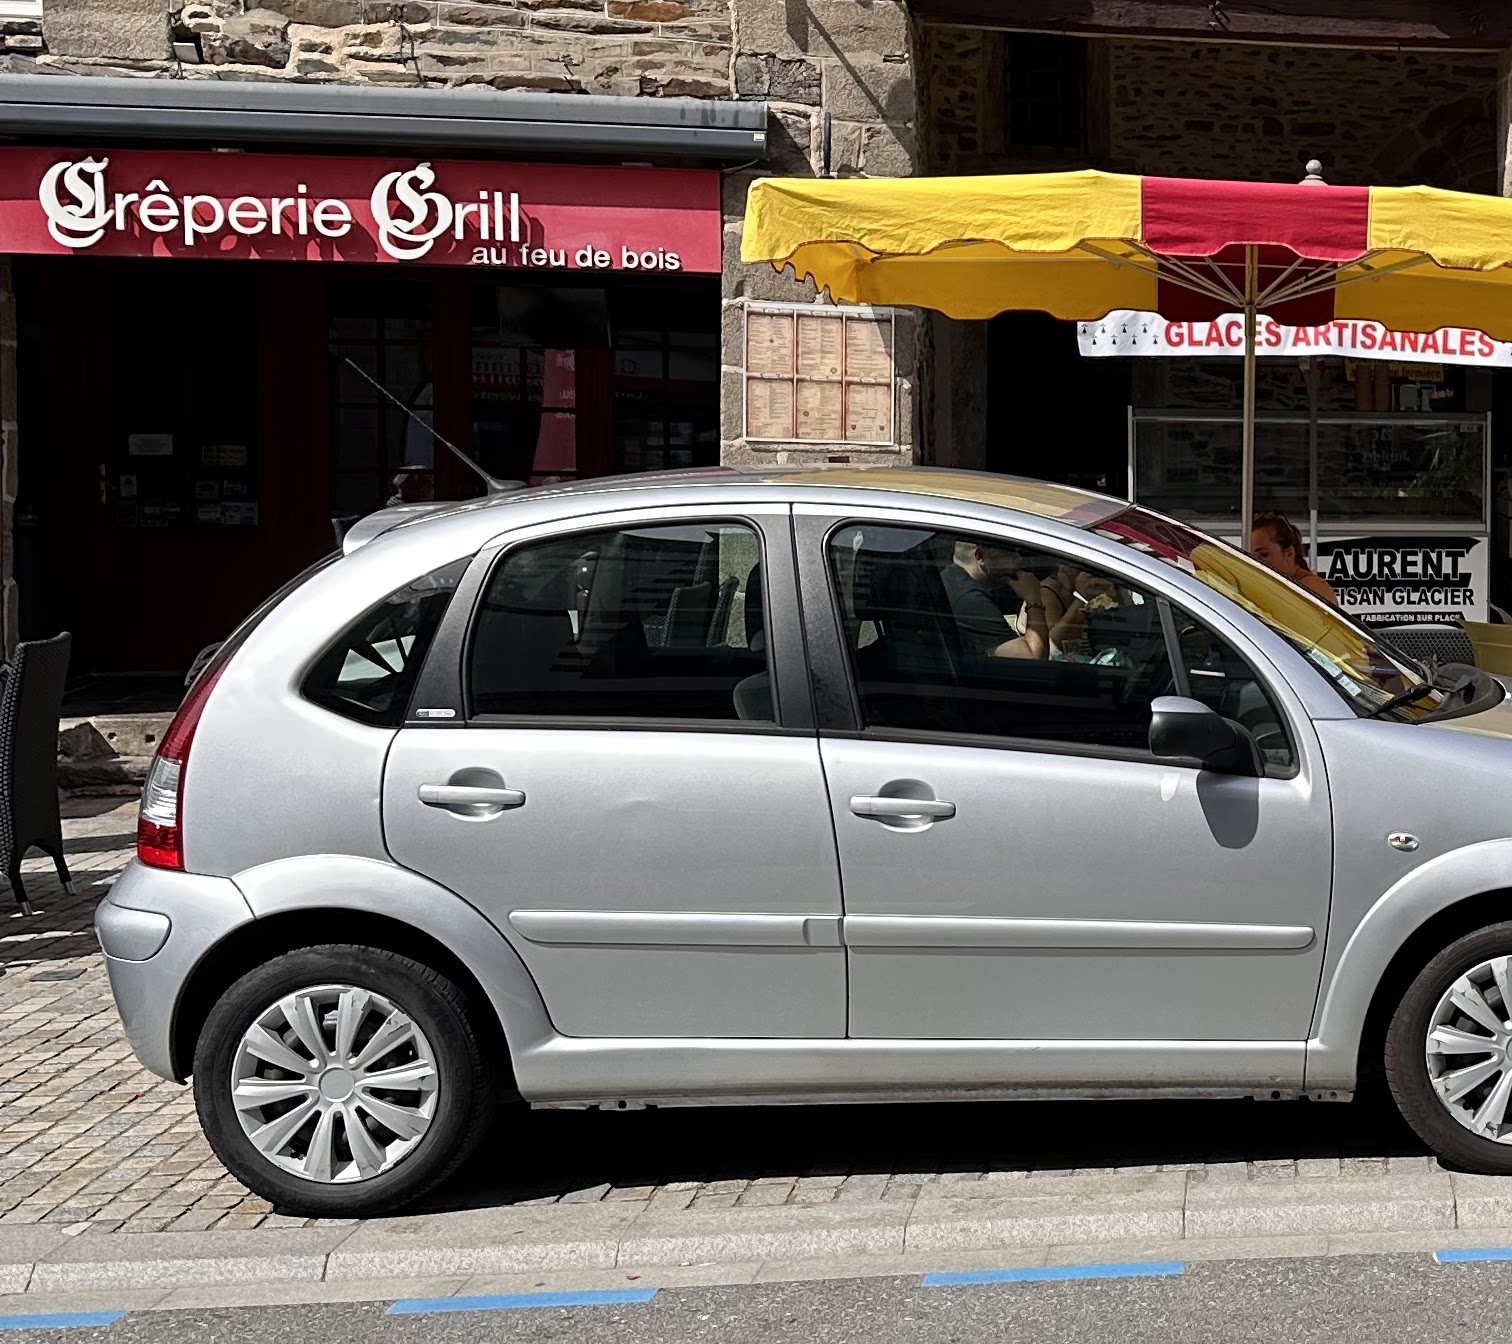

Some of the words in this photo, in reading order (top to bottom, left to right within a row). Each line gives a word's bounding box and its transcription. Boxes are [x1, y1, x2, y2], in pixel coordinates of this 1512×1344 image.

[38, 156, 353, 248] Crêperie
[371, 162, 521, 261] Grill
[472, 246, 507, 266] au
[519, 243, 567, 267] feu
[575, 244, 611, 269] de
[622, 245, 681, 271] bois
[1164, 320, 1282, 348] GLACES
[1291, 322, 1495, 358] ARTISANALES
[1317, 548, 1467, 581] AURENT
[1391, 587, 1475, 606] GLACIER
[1360, 614, 1415, 623] FABRICATION
[1416, 614, 1434, 623] SUR
